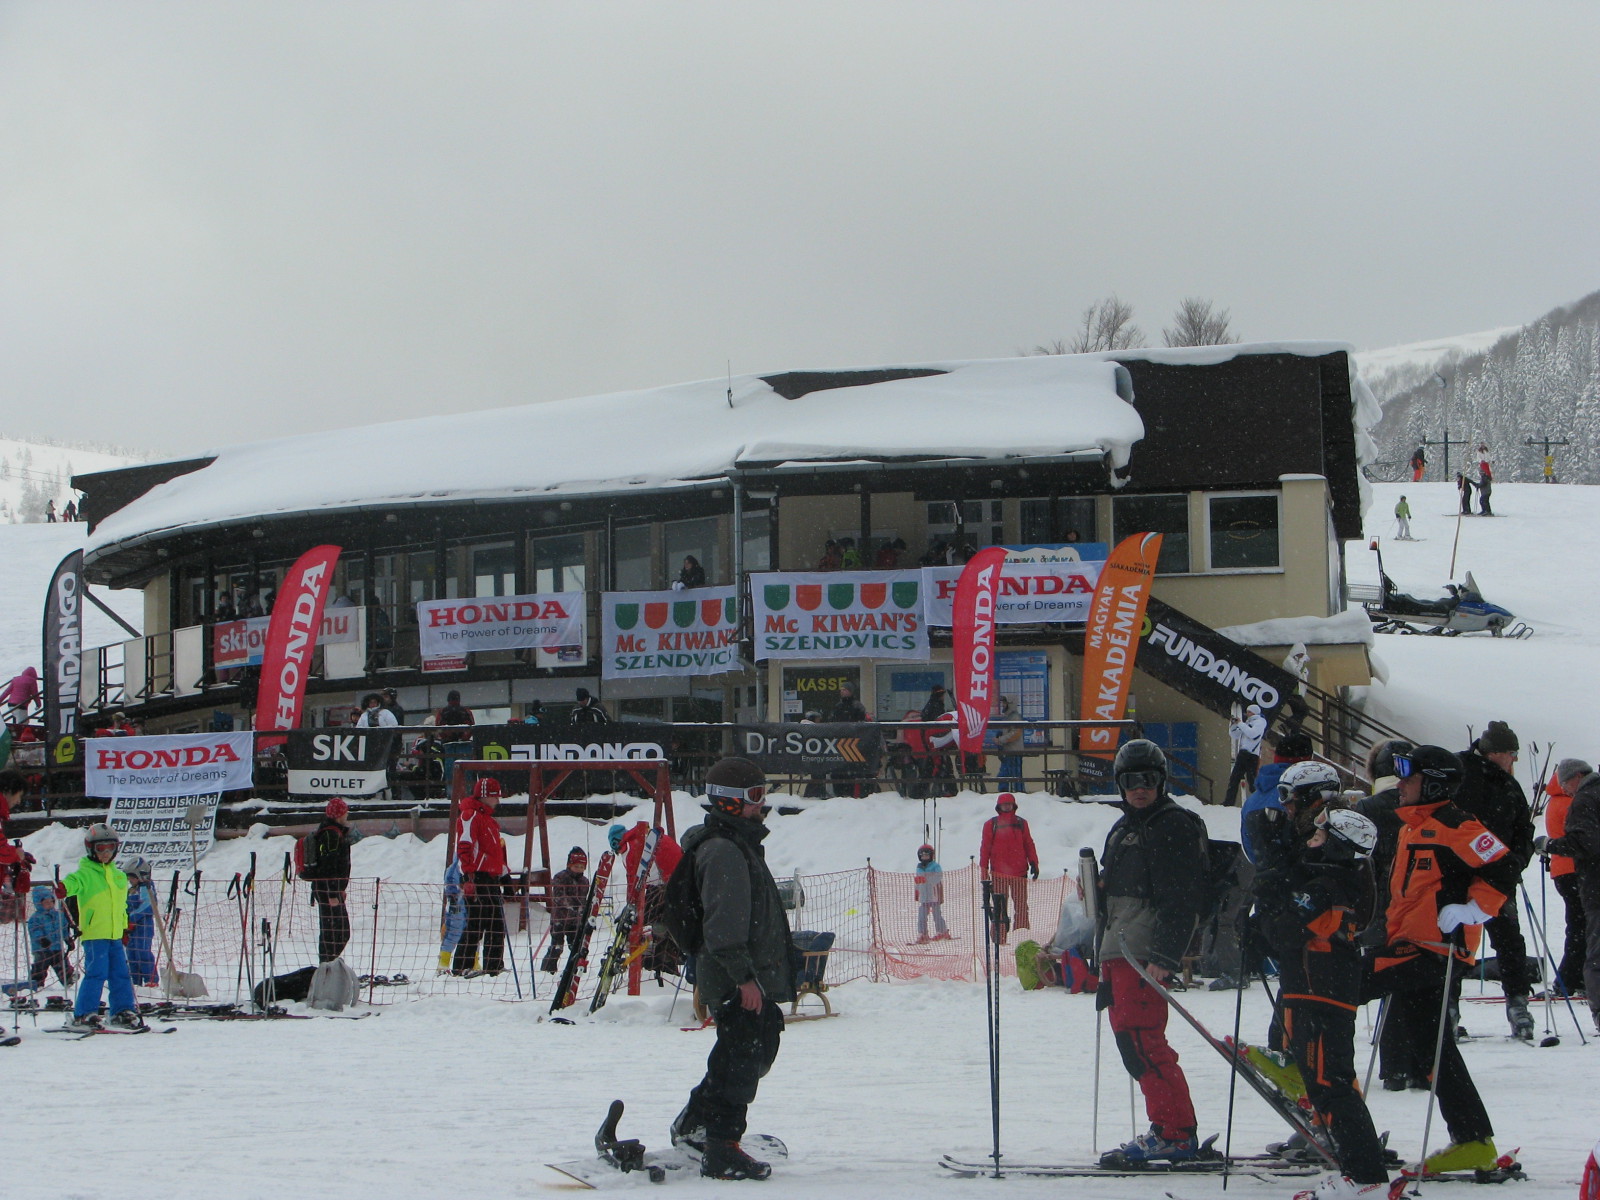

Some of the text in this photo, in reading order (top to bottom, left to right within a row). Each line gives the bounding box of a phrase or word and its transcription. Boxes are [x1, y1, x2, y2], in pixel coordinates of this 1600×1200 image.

[935, 574, 1095, 600] HNDA
[428, 600, 570, 628] HONDA
[1017, 600, 1029, 611] of
[1034, 600, 1083, 610] Dreams
[764, 612, 918, 634] Mc KIWAN'S
[1090, 585, 1115, 649] MAGYAR
[440, 625, 558, 641] The Power of Dreams
[764, 633, 917, 651] SZENDVICS
[970, 564, 993, 701] HONDA
[274, 561, 327, 731] HONDA
[615, 634, 647, 653] Mc
[1090, 584, 1142, 744] SAKADÉMIA
[1147, 622, 1279, 709] FUNDANGO
[796, 676, 848, 692] KASSE
[312, 734, 367, 762] SKI
[510, 742, 664, 761] FUNDANGO
[746, 732, 839, 755] Dr.Sox
[96, 743, 240, 770] HONDA
[107, 769, 228, 785] The Power of Dreams
[309, 778, 366, 789] OUTLET
[117, 794, 218, 809] ski ski ski ski ski
[131, 820, 151, 832] ski
[153, 819, 172, 831] ski
[124, 844, 144, 854] ski
